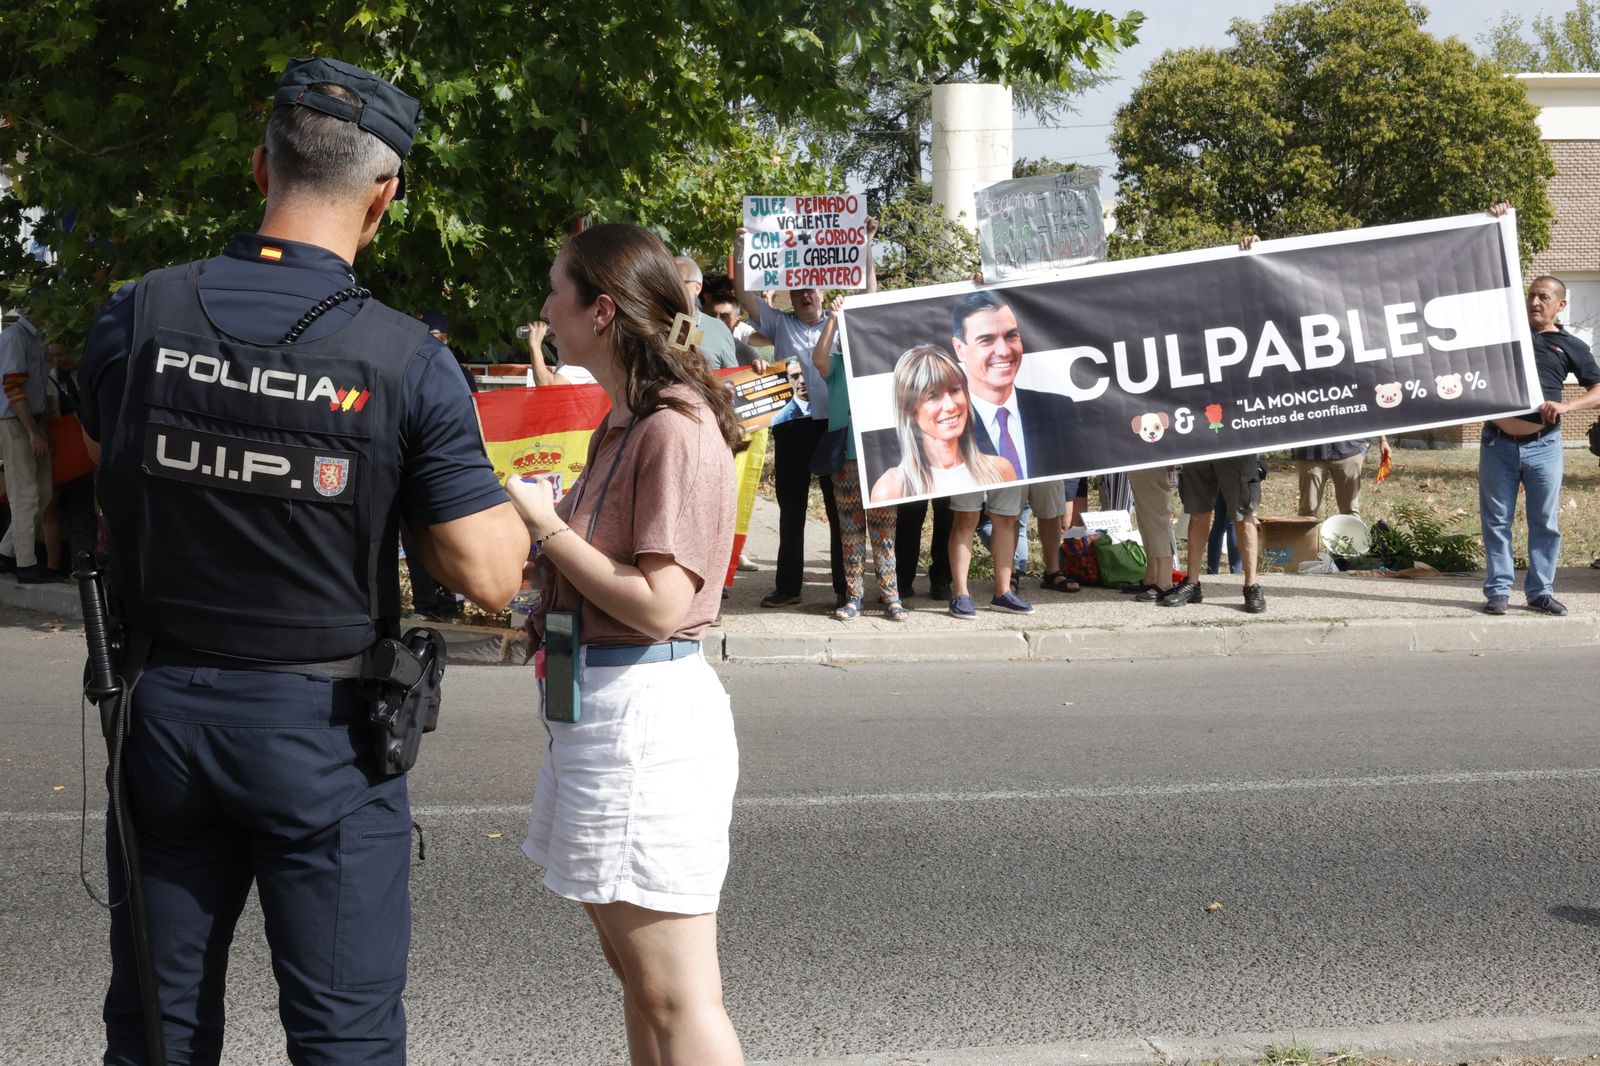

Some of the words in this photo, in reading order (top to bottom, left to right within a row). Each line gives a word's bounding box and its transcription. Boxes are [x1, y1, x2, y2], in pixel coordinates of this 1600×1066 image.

[750, 197, 786, 217] JUEZ
[751, 231, 781, 250] CON
[815, 226, 866, 246] GORDOS
[748, 251, 779, 270] QUE
[784, 250, 800, 268] EL
[803, 246, 859, 267] CABALLO
[764, 270, 779, 287] DE
[785, 265, 863, 287] ESPARTERO
[1058, 296, 1468, 402] CULPABLES
[155, 347, 340, 404] POLICIA
[1236, 396, 1266, 413] "LA
[1267, 384, 1359, 409] MONCLOA"
[1231, 413, 1287, 430] Chorizos
[1289, 410, 1305, 422] de
[1307, 402, 1368, 420] confianza
[156, 434, 302, 489] U.I.P.
